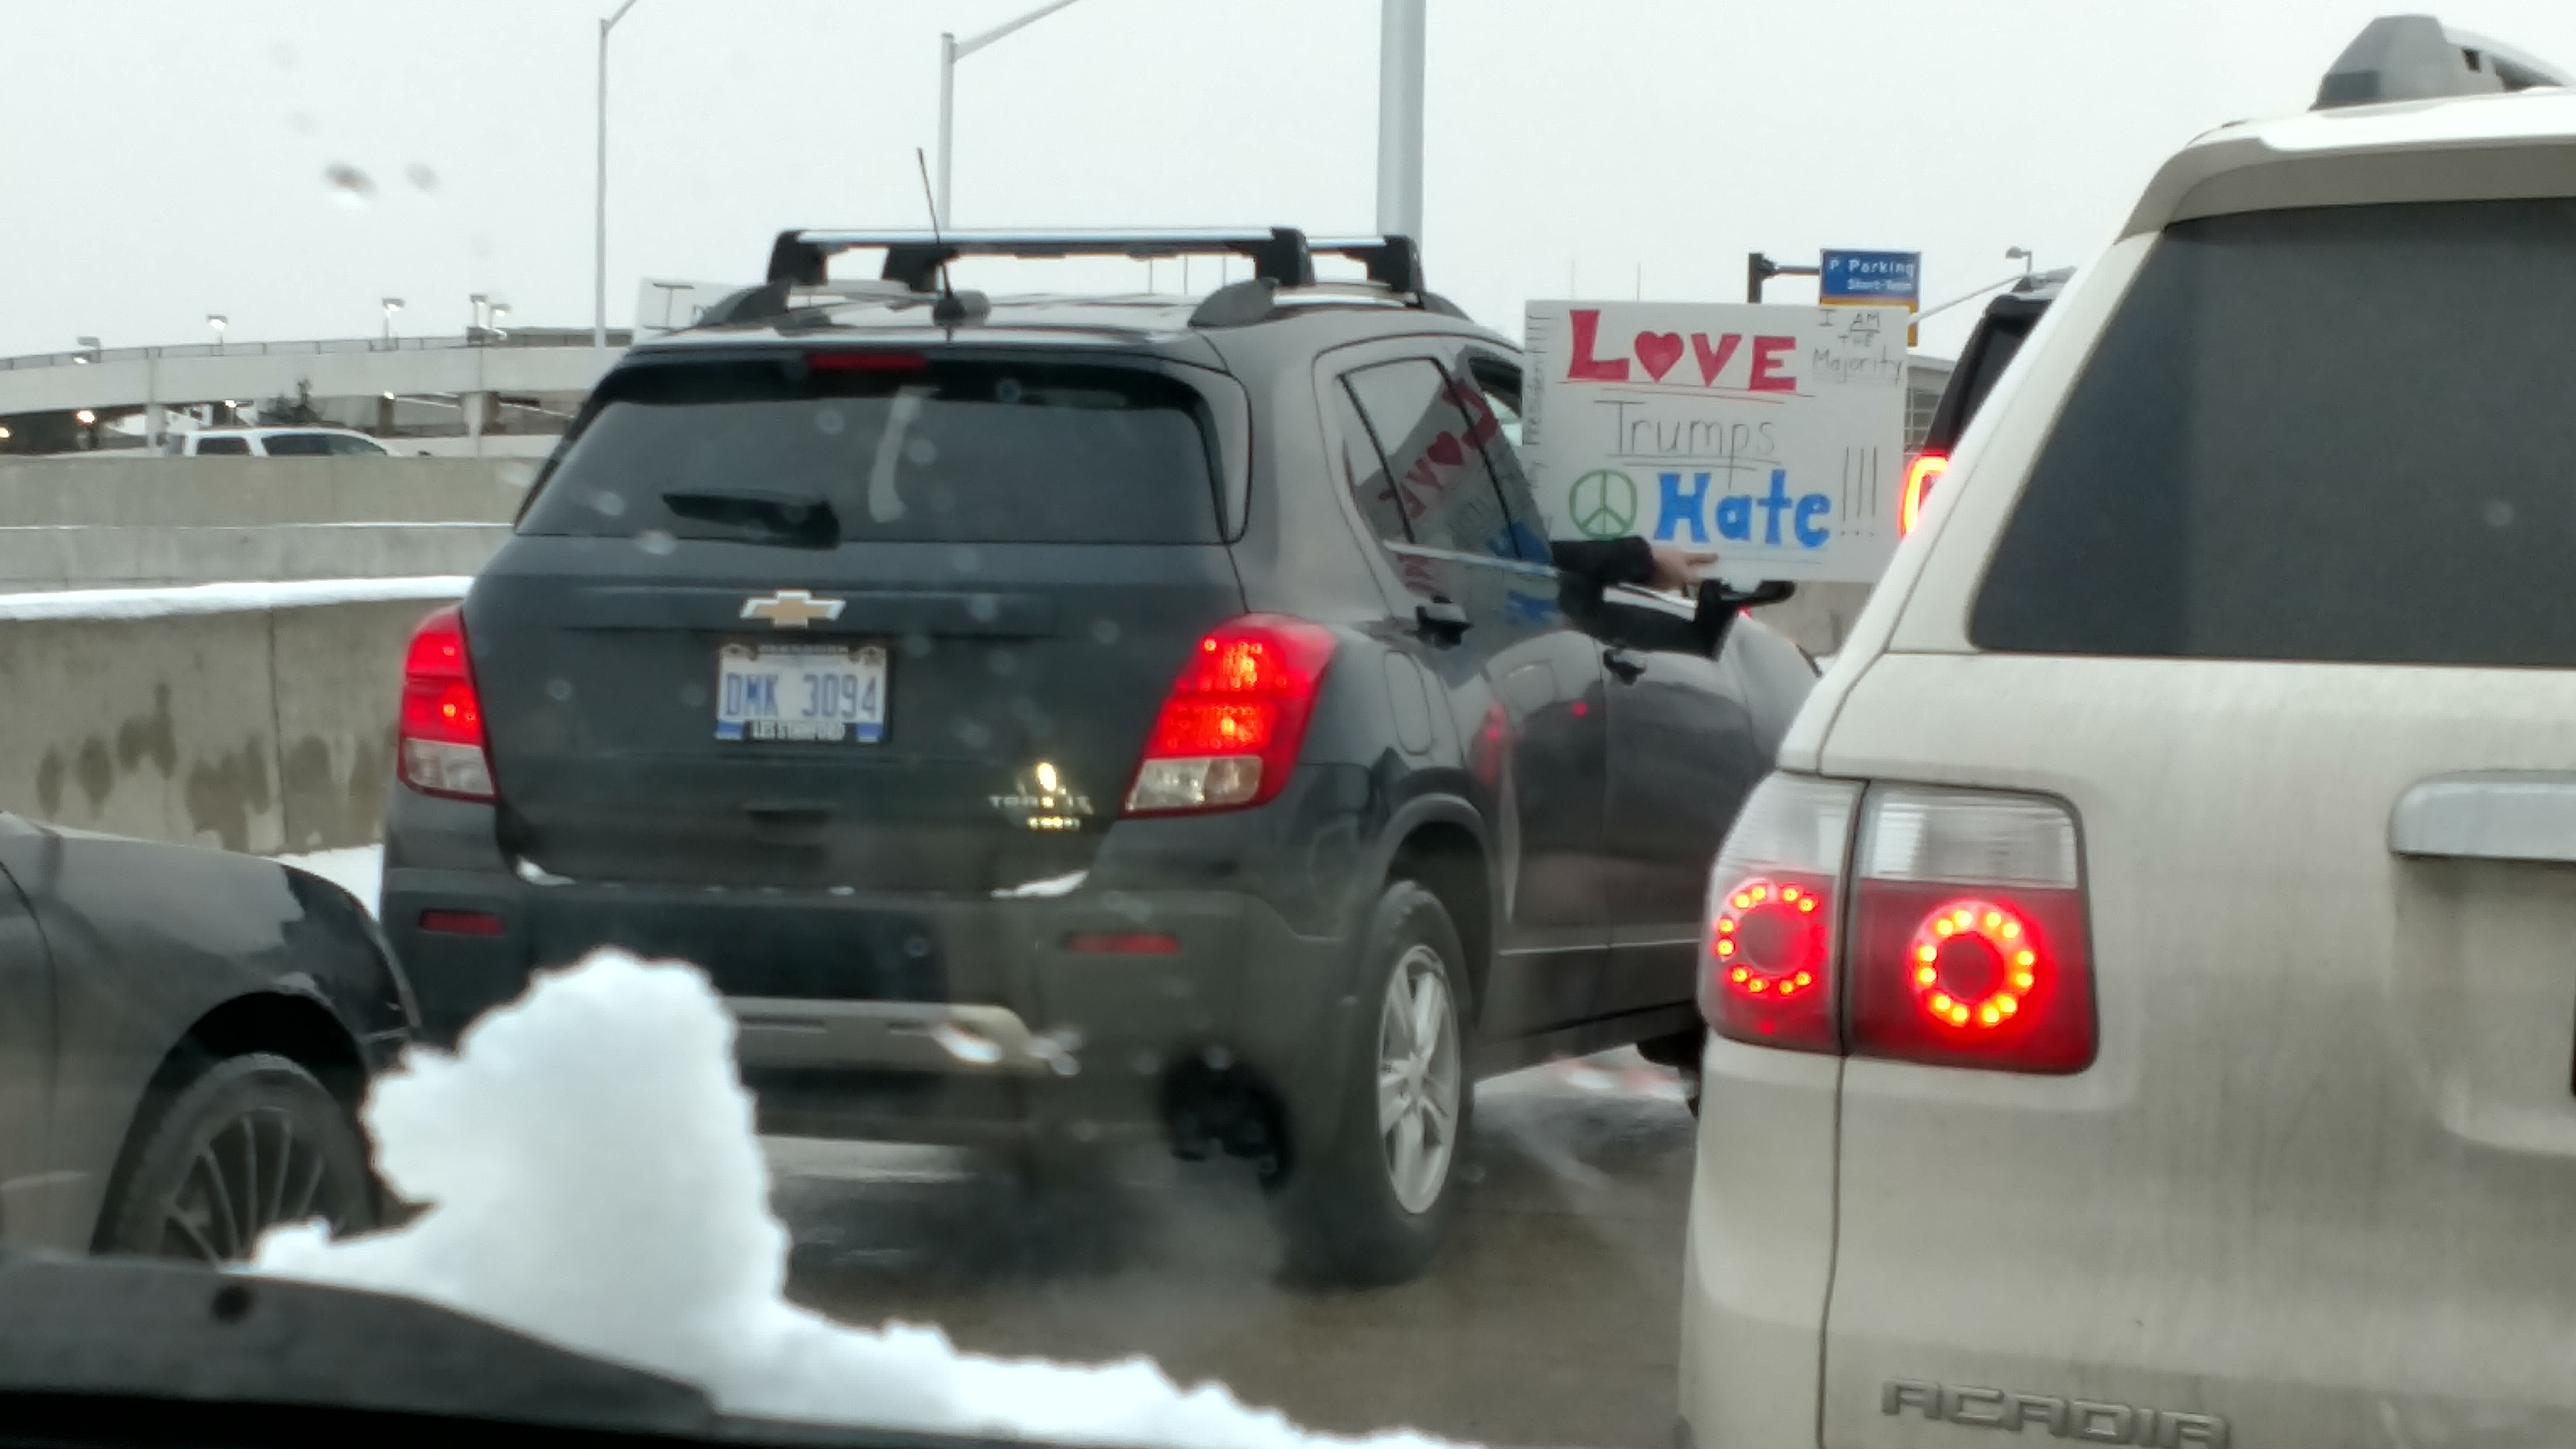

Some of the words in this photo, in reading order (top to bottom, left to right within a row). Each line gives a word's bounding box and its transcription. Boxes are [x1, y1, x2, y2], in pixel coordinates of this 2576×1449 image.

[1848, 258, 1913, 279] Parking
[1594, 400, 1779, 490] Trumps
[726, 673, 779, 717] DMK
[802, 673, 877, 719] 3094
[1881, 1378, 2230, 1449] ACADIA
